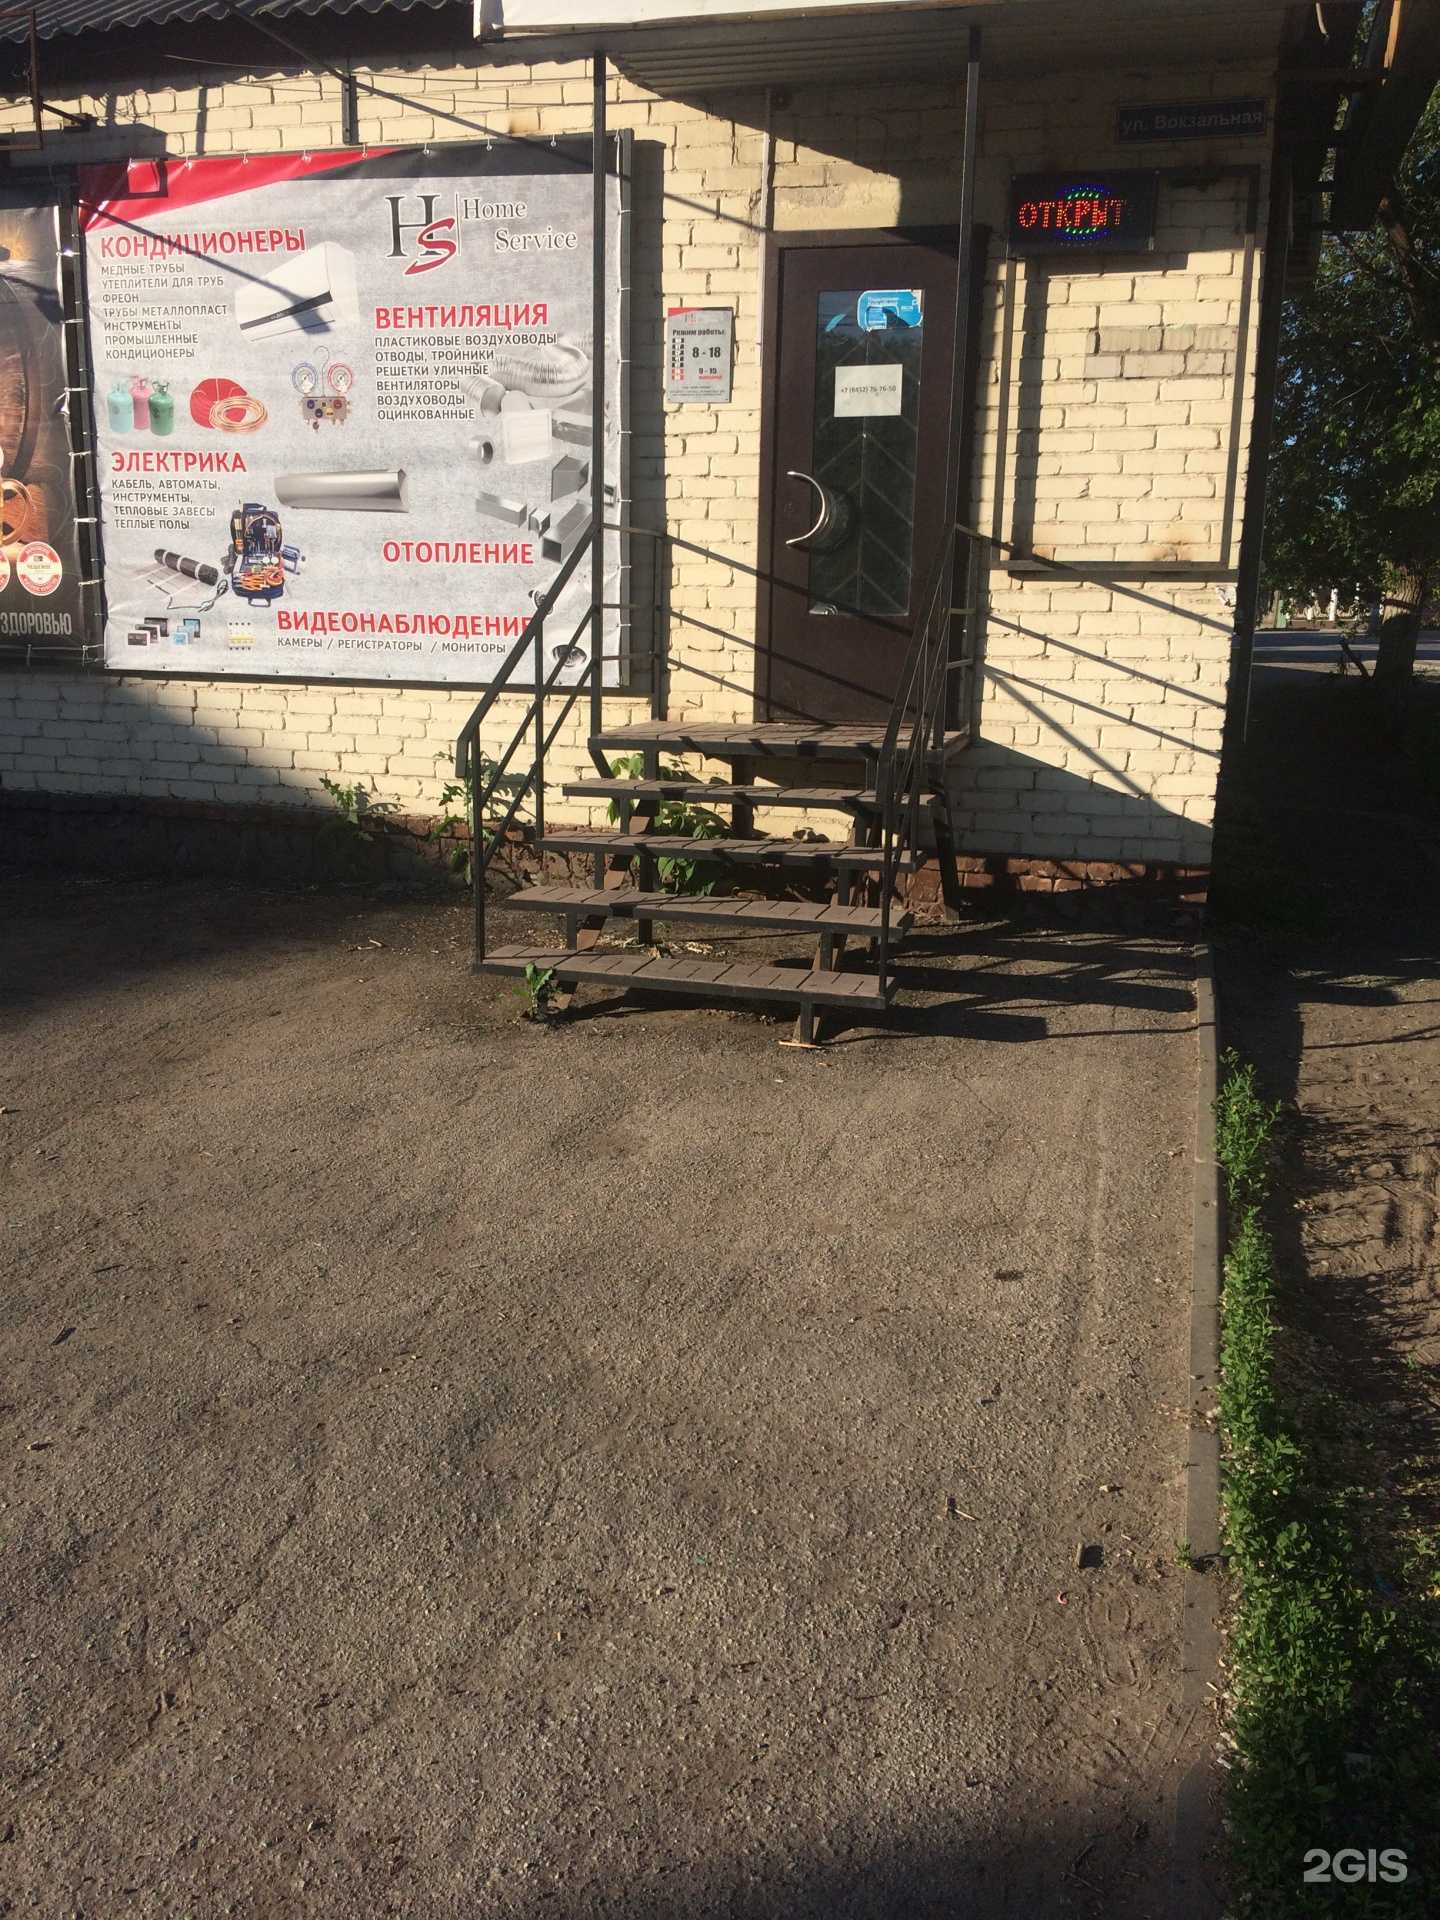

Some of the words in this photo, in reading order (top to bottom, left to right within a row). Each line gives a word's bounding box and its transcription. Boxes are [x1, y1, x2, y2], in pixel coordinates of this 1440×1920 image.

[1155, 110, 1263, 129] Вокзальная
[463, 199, 527, 219] Home
[100, 228, 306, 260] КОНДИЦИОНЕРЫ
[496, 227, 577, 250] Service
[101, 264, 146, 276] МЕДНЫЕ
[149, 262, 185, 274] ТРУБЫ
[102, 278, 168, 290] УТЕПЛИТЕЛИ
[172, 277, 194, 289] ДЛЯ
[197, 276, 224, 287] ТРУБ
[102, 293, 139, 303] ФРЕОН
[104, 307, 138, 318] ТРУБЫ
[141, 304, 228, 317] МЕТАЛЛОПЛАСТ
[375, 303, 548, 330] ВЕНТИЛЯЦИЯ
[104, 320, 182, 331] ИНСТРУМЕНТЫ
[105, 333, 199, 345] ПРОМЫШЛЕННЫЕ
[375, 335, 462, 347] ПЛАСТИКОВЫЕ
[465, 334, 557, 347] ВОЗДУХОВОДЫ
[105, 348, 195, 360] КОНДИЦИОНЕРЫ
[375, 351, 428, 362] ОТВОДЫ,
[431, 348, 494, 361] ТРОЙНИКИ
[692, 346, 700, 358] 8
[709, 346, 721, 358] 18
[376, 365, 429, 377] РЕШЕТКИ
[433, 364, 489, 376] УЛИЧНЫЕ
[376, 380, 460, 391] ВЕНТИЛЯТОРЫ
[377, 394, 465, 407] ВОЗДУХОВОДЫ
[377, 409, 475, 421] ОЦИНКОВАННЫЕ
[111, 451, 247, 473] ЭЛЕКТРИКА
[111, 479, 155, 491] КАБЕЛЬ,
[158, 479, 221, 491] АВТОМАТЫ,
[112, 492, 193, 504] ИНСТРУМЕНТЫ,
[114, 506, 170, 517] ТЕПЛОВЫЕ
[173, 507, 215, 517] ЗАВЕСЫ
[114, 519, 156, 530] ТЕПЛЫЕ
[159, 519, 190, 530] ПОЛЫ
[383, 541, 534, 564] ОТОПЛЕНИЕ
[0, 611, 73, 636] ЗДОРОВЬЮ
[277, 637, 323, 649] КАМЕРЫ
[338, 639, 423, 651] РЕГИСТРАТОРЫ
[441, 641, 506, 653] МОНИТОРЫ
